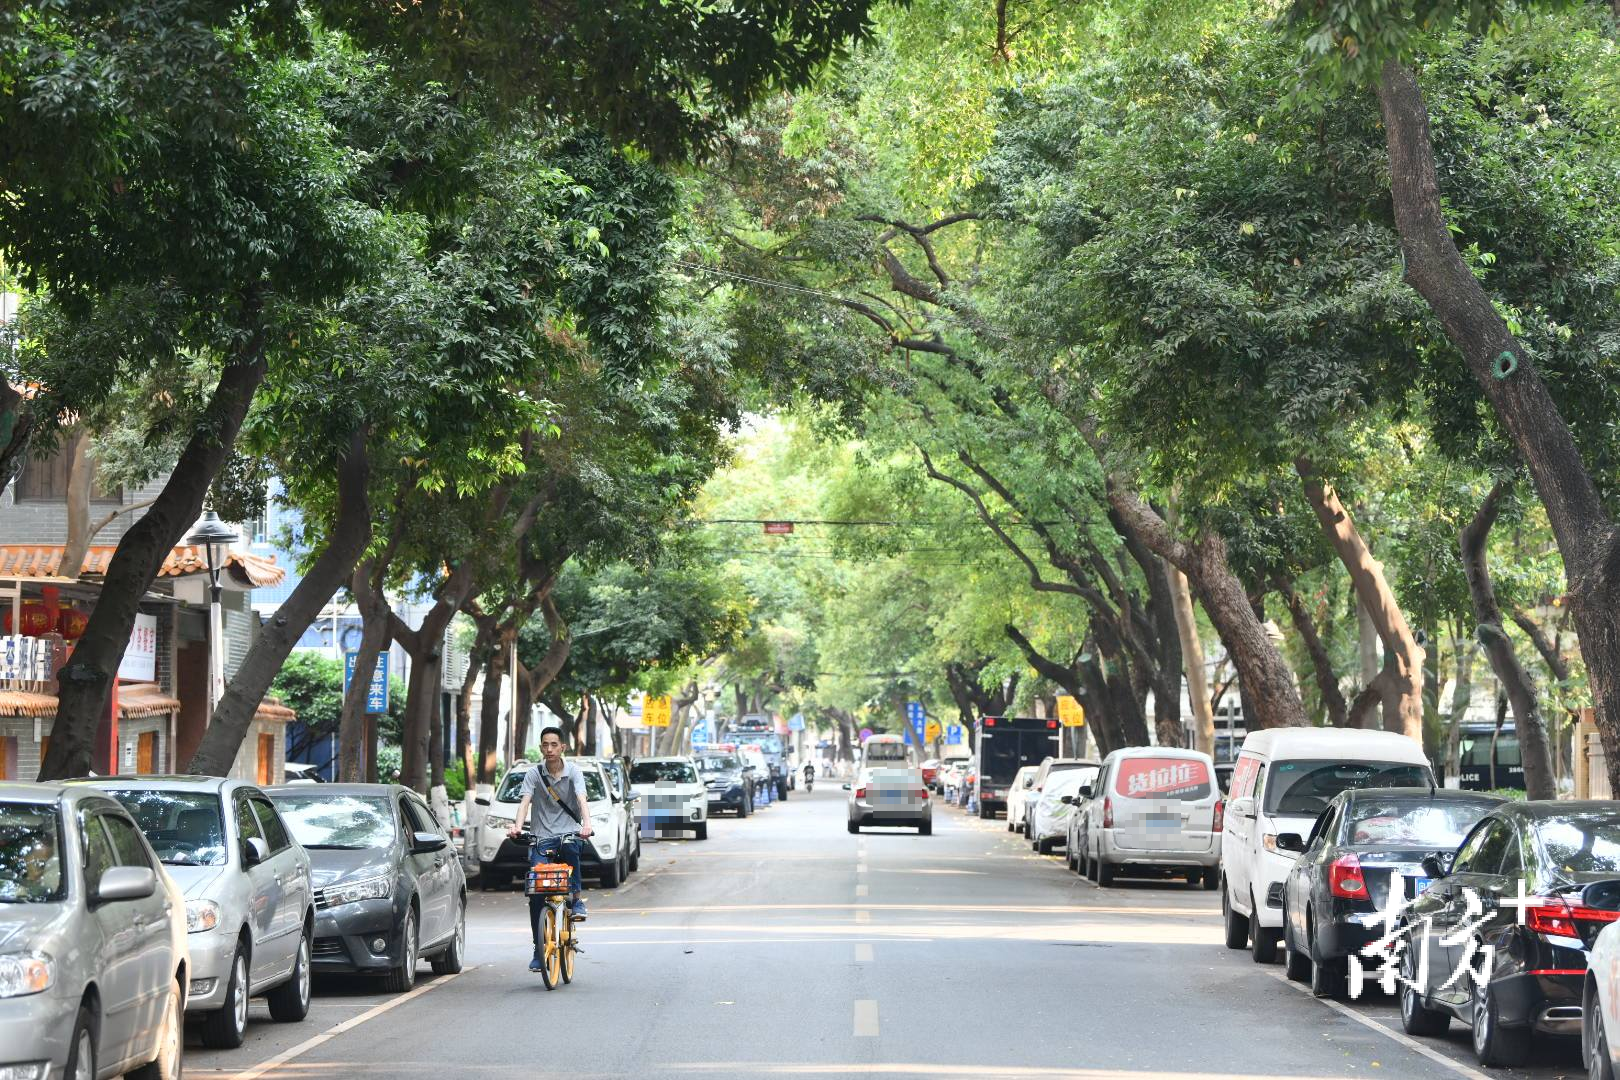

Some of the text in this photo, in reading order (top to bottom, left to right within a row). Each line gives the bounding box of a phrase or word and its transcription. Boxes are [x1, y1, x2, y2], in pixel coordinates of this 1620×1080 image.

[645, 712, 668, 724] 车位
[950, 725, 958, 735] P
[1127, 763, 1199, 796] 货拉拉
[1459, 773, 1480, 782] LICE
